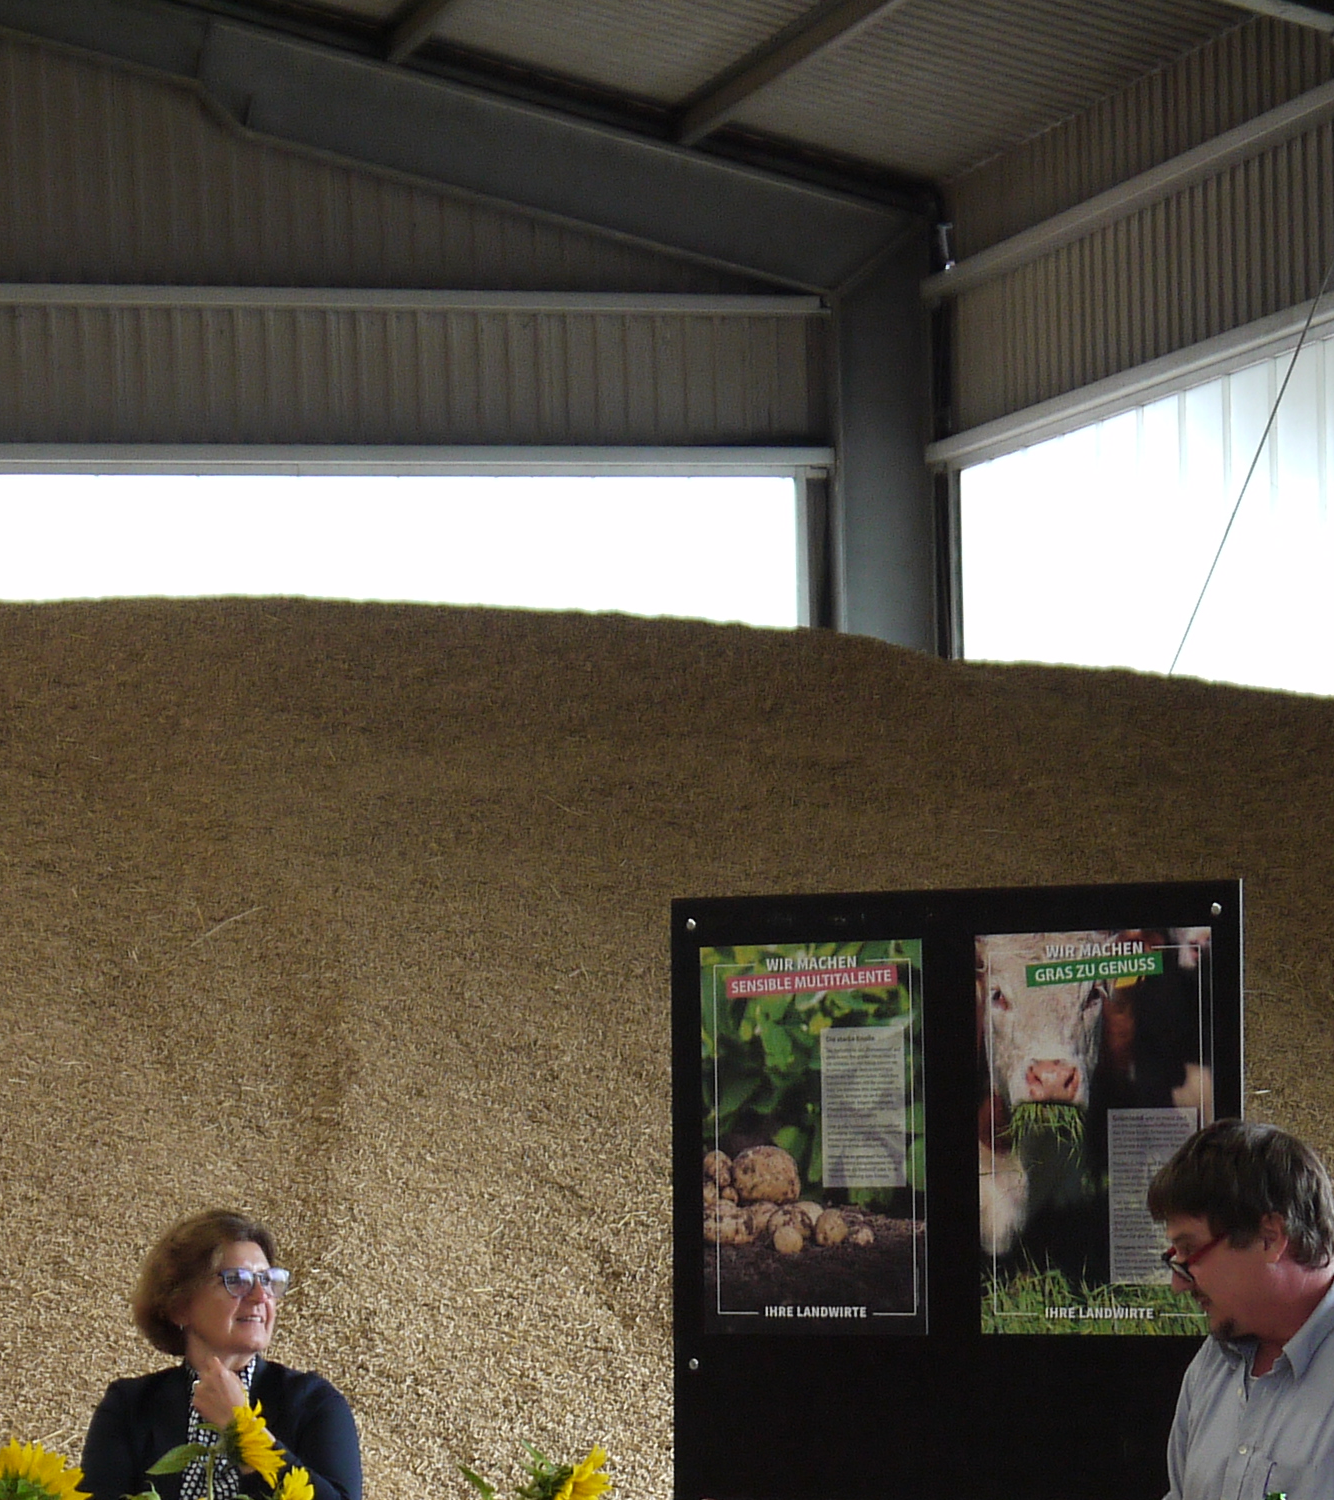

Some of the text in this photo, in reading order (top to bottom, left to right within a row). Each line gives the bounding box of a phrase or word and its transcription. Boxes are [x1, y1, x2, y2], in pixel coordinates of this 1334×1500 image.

[1045, 941, 1144, 958] WIR MACHEN
[766, 955, 857, 972] WIR MACHEN
[1035, 957, 1156, 982] GRAS ZU GENUSS
[731, 969, 892, 994] SENSIBLE MULTITALENTE
[765, 1306, 867, 1318] IHRE LANDWIRTE
[1045, 1306, 1155, 1319] IHRE LANDWIRTE
